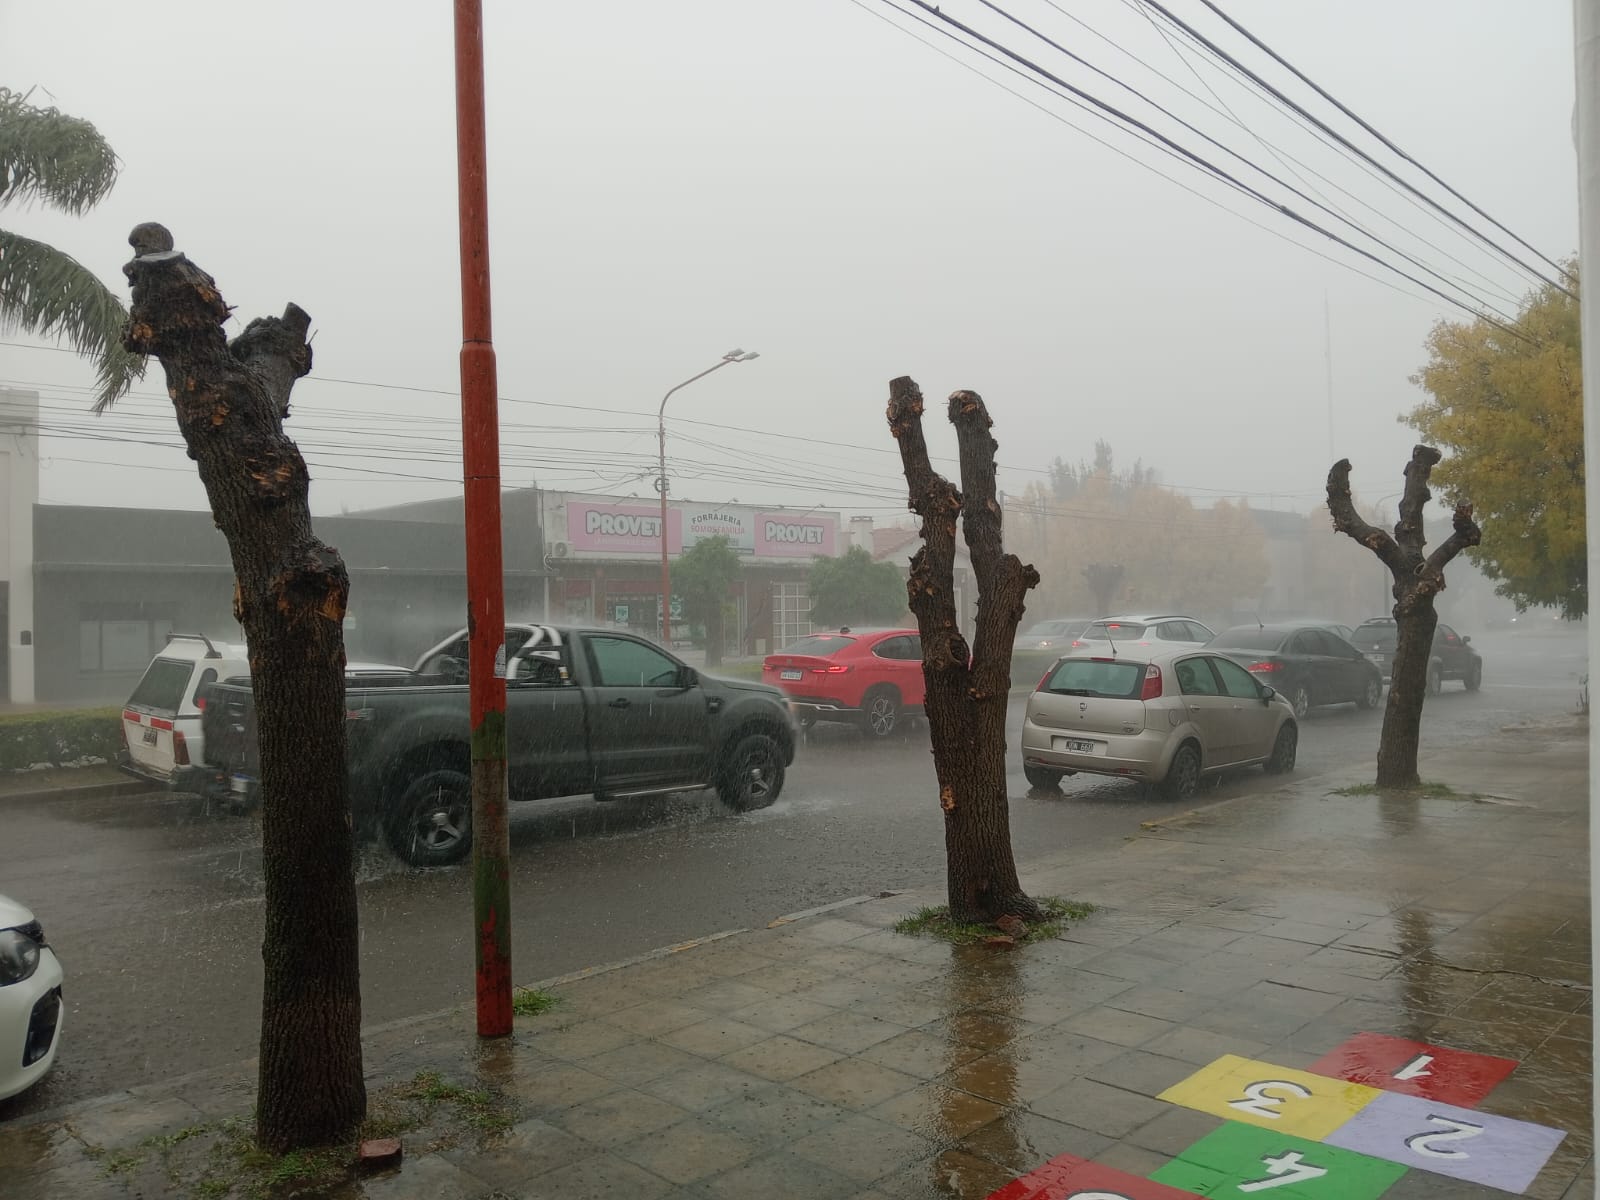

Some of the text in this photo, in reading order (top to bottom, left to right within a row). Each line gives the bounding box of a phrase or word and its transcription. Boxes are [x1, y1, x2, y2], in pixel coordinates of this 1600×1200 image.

[585, 510, 662, 538] PROVET
[691, 513, 742, 526] FORRAJERIA
[765, 520, 825, 545] PROVET
[1393, 1055, 1434, 1080] 1
[1228, 1079, 1312, 1119] 3
[1404, 1113, 1484, 1160] 2
[1237, 1151, 1329, 1193] 4
